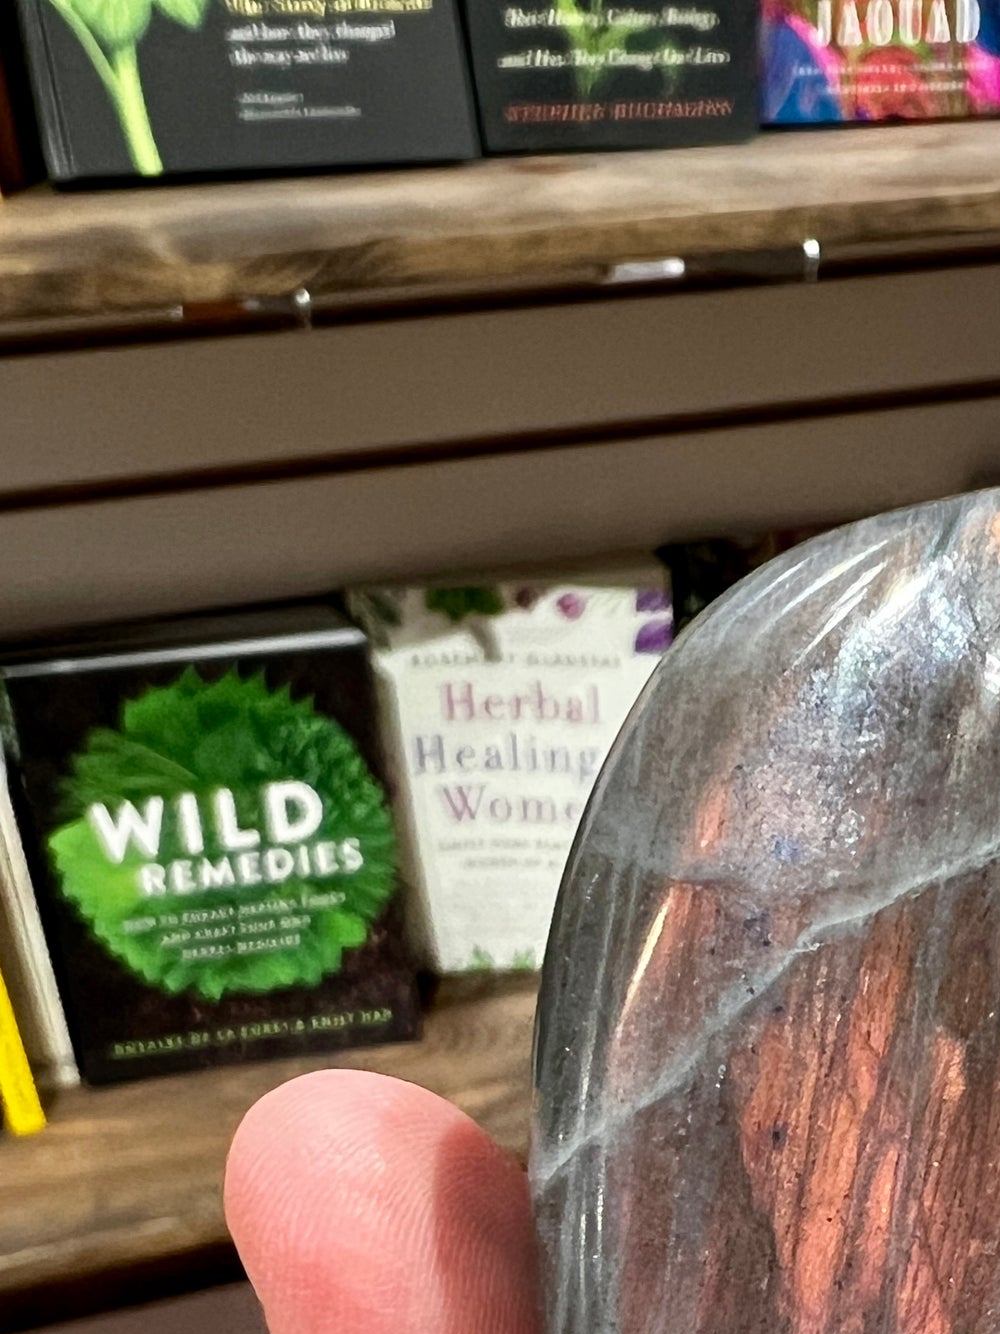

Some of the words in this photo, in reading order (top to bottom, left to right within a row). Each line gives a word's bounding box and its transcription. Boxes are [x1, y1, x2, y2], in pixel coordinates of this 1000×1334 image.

[442, 680, 600, 723] Herbal
[415, 732, 602, 783] Healing
[90, 778, 323, 864] WILD
[442, 784, 583, 825] Wome
[139, 836, 364, 896] REMEDIES
